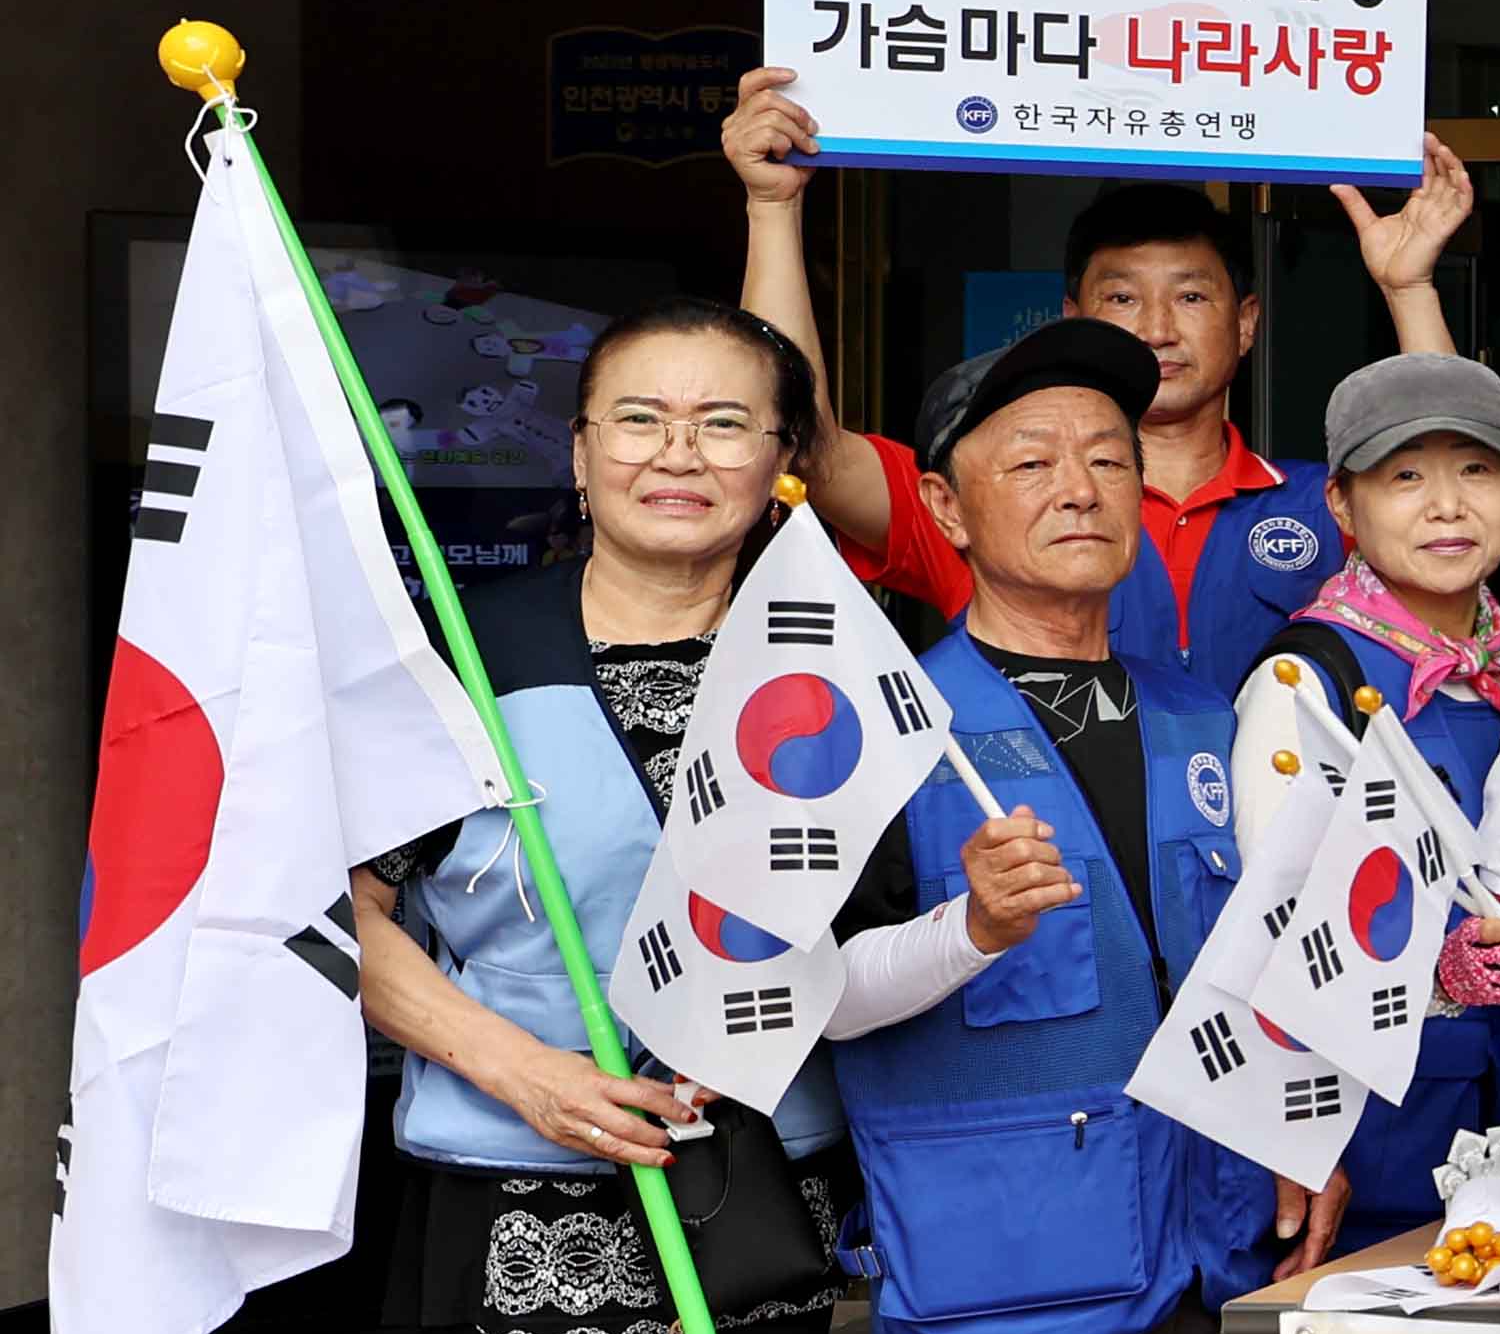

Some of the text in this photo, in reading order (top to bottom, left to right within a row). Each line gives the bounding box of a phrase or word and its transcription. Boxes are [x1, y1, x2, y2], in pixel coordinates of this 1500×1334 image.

[812, 0, 1393, 96] 가슴마다 나라사랑
[1013, 103, 1257, 141] 한국자유총연맹
[1263, 538, 1304, 553] KFF
